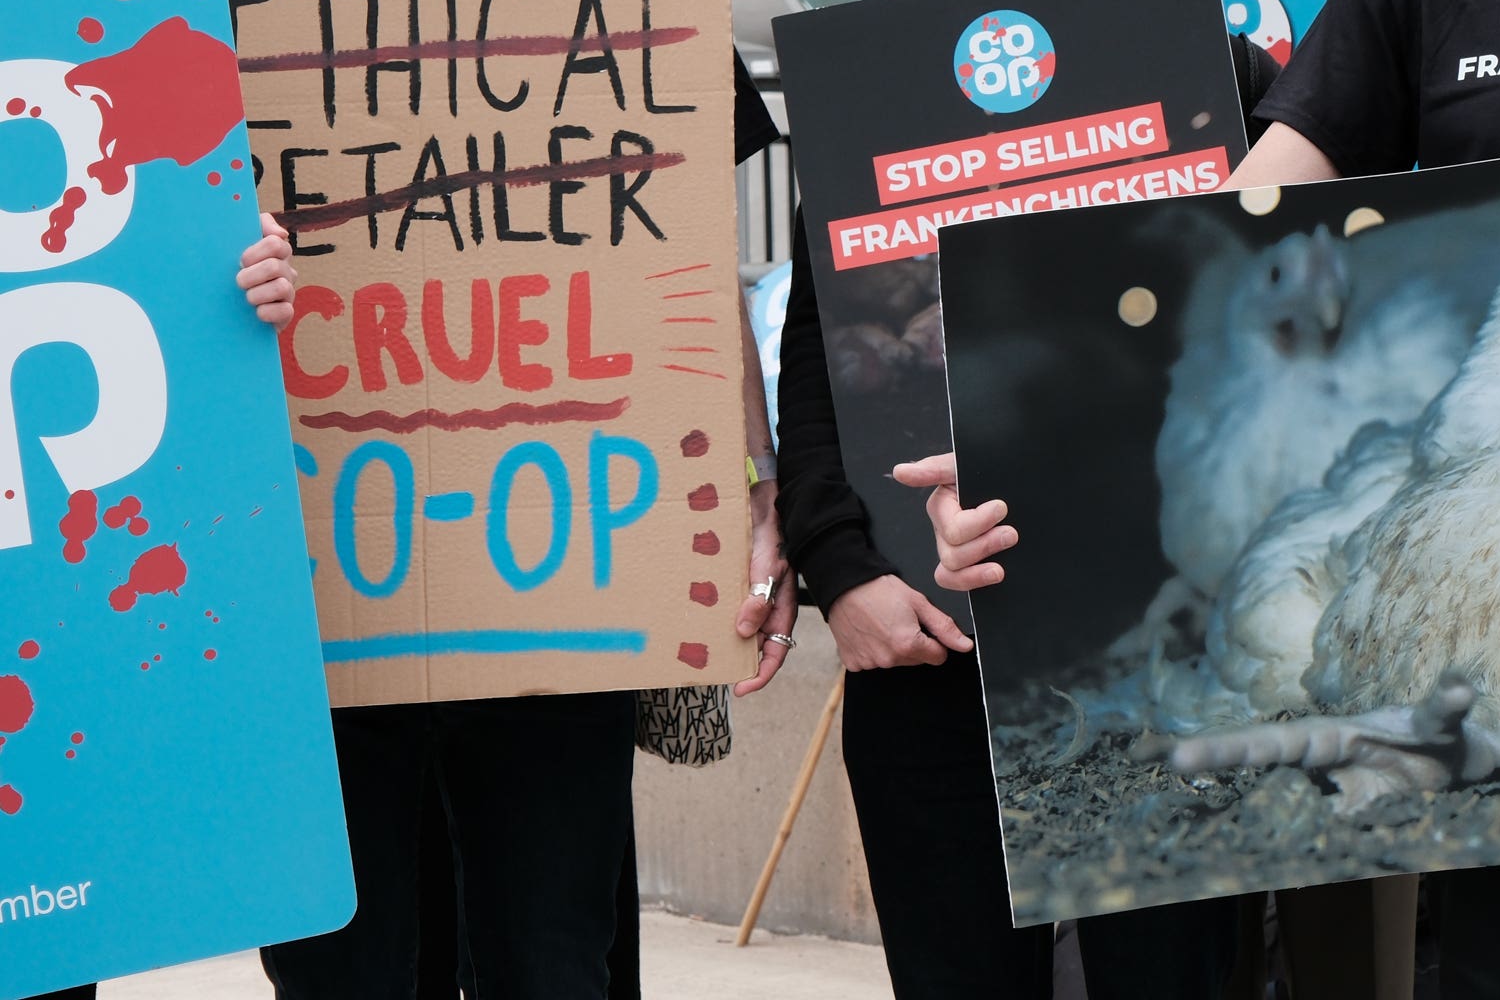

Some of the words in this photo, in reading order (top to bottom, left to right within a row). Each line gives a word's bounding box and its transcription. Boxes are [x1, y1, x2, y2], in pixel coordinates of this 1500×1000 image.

[969, 24, 1034, 63] CO
[251, 126, 668, 257] ETAILER
[886, 149, 987, 192] STOP
[997, 116, 1156, 172] SELLING
[284, 271, 634, 400] CRUEL
